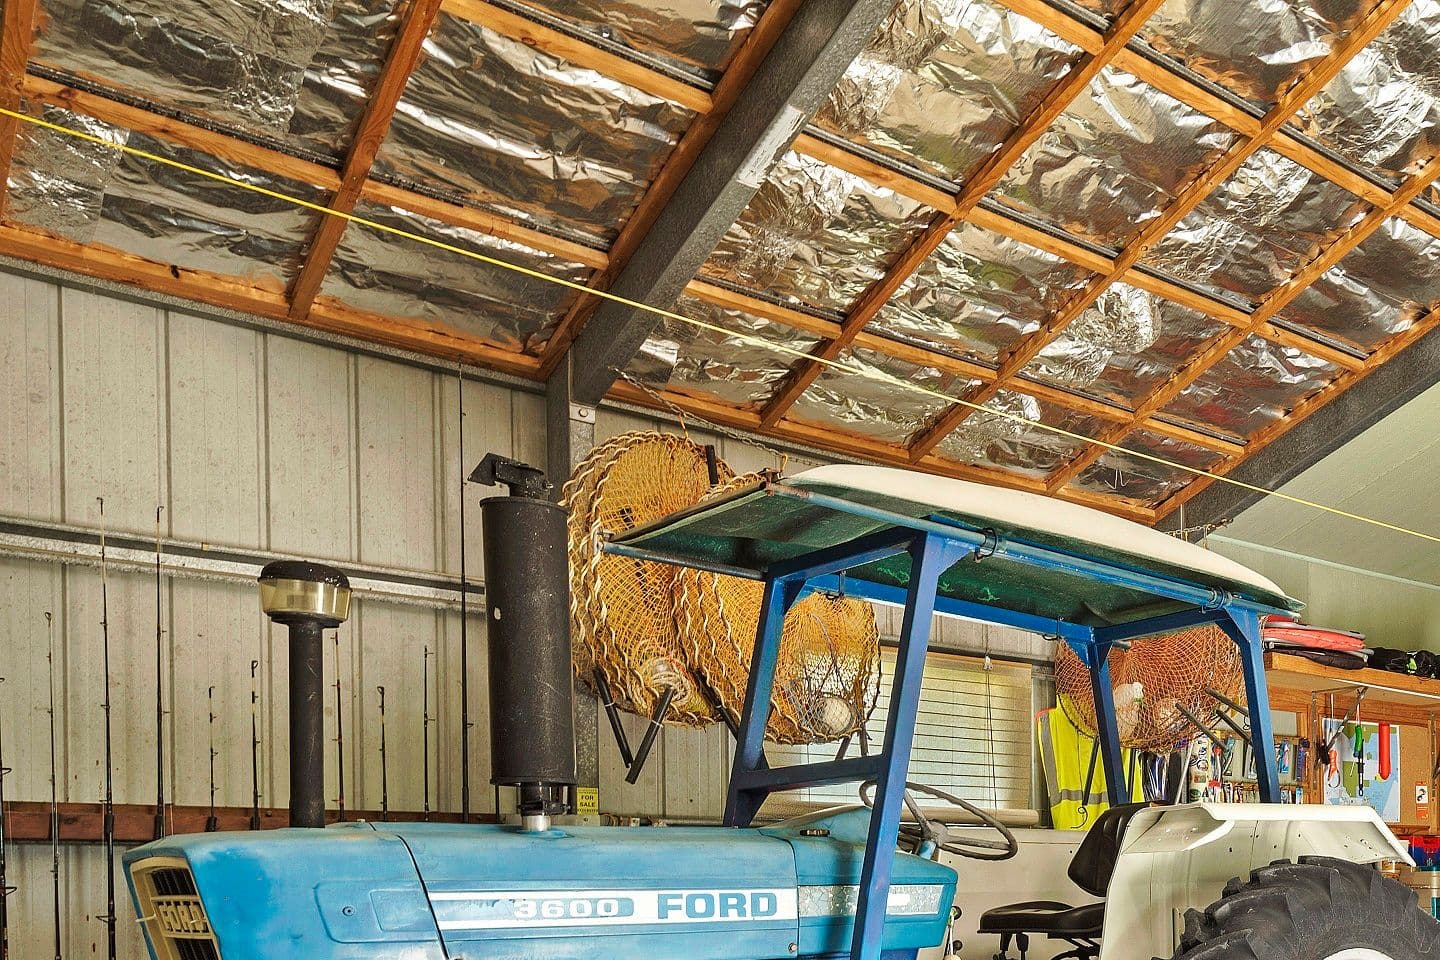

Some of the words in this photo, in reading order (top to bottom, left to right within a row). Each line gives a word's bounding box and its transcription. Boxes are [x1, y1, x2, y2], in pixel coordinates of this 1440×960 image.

[158, 904, 206, 931] FORD
[513, 899, 619, 919] 3600
[657, 892, 778, 920] FORD
